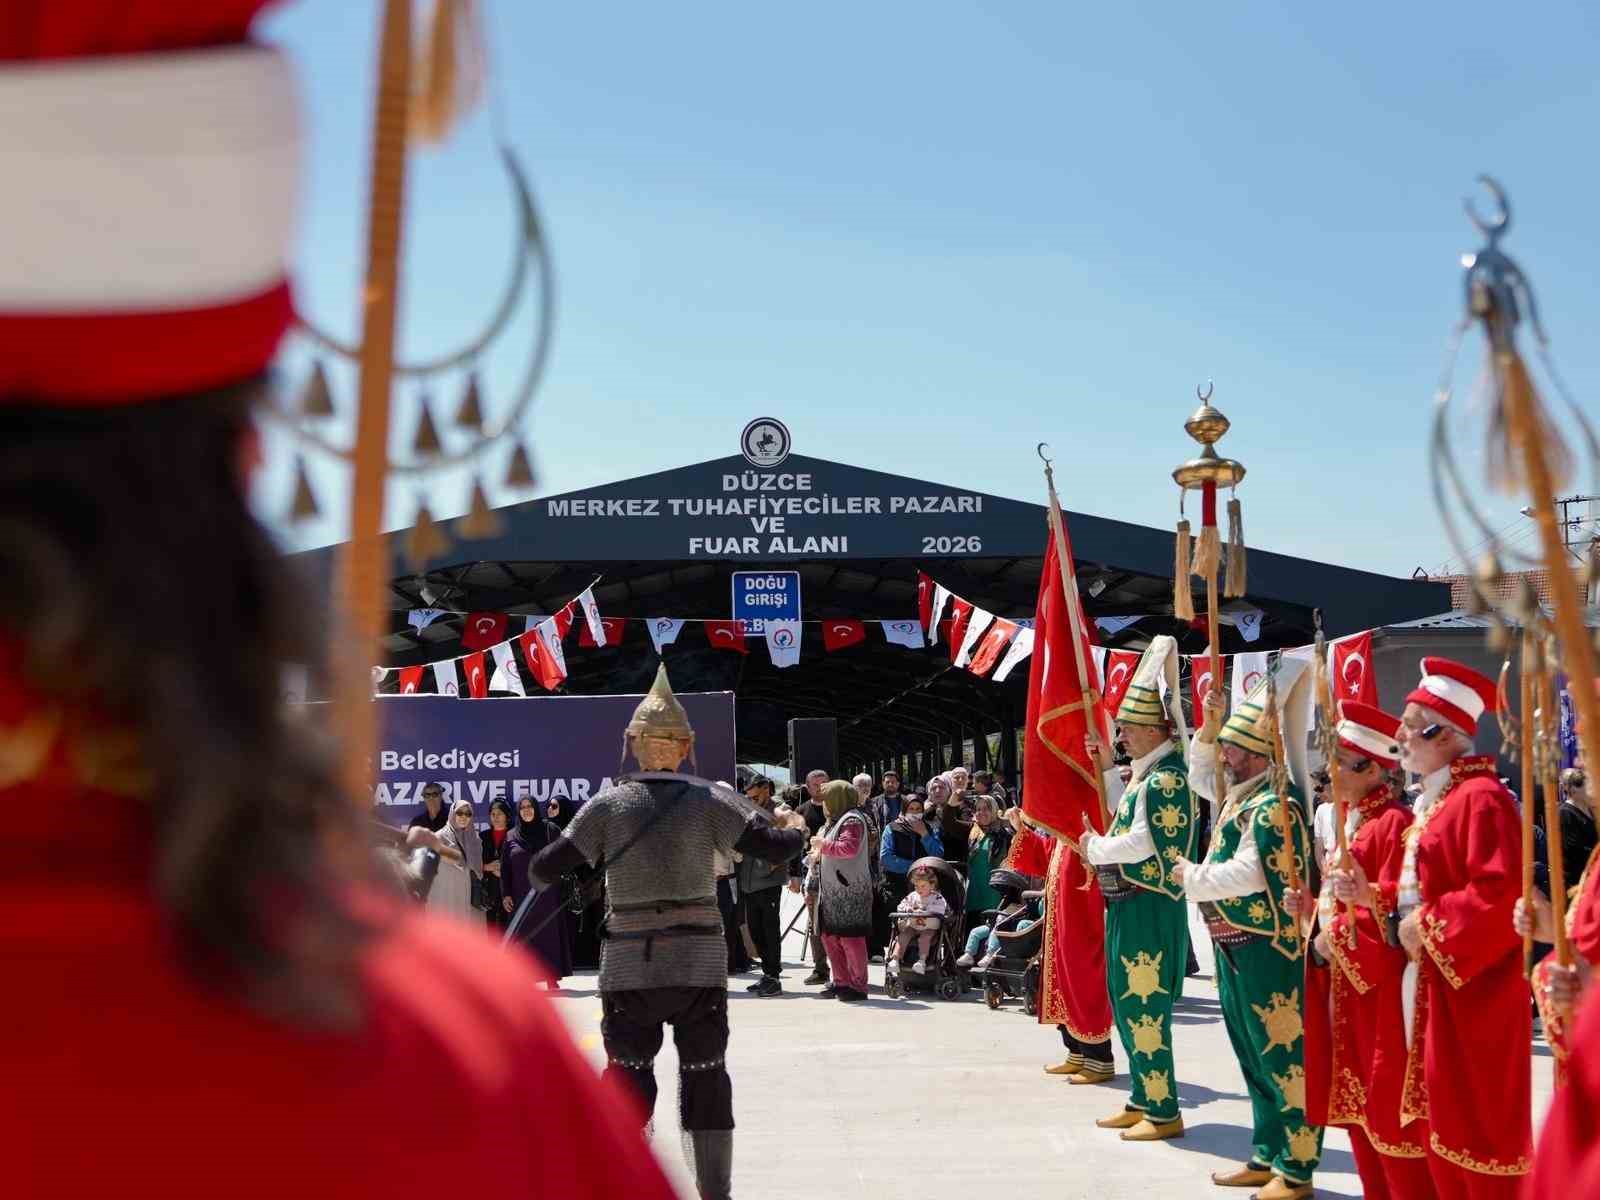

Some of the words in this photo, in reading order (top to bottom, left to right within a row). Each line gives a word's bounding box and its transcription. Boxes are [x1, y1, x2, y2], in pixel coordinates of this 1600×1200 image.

[722, 470, 812, 491] DÜZCE
[548, 499, 660, 517] MERKEZ
[668, 493, 882, 516] TUHAFİYECİLER
[890, 496, 983, 513] PAZARI
[751, 517, 785, 533] VE
[689, 537, 760, 554] FUAR
[768, 536, 848, 553] ALANI
[922, 536, 982, 553] 2026
[745, 575, 786, 590] DOĞU
[380, 749, 520, 773] Belediyesi
[370, 780, 461, 806] AZARI
[468, 780, 506, 803] VE
[512, 777, 591, 802] FUAR
